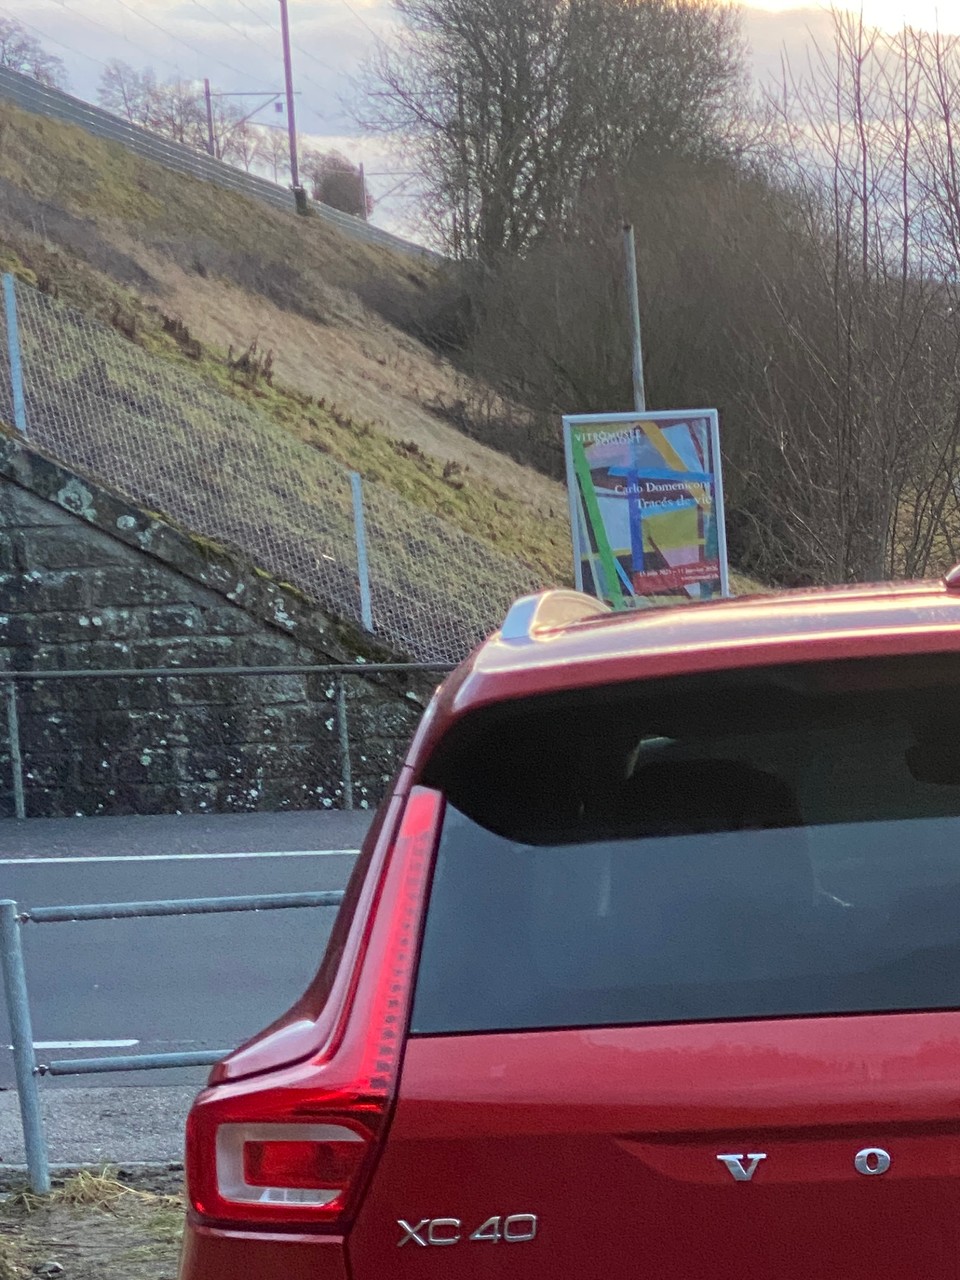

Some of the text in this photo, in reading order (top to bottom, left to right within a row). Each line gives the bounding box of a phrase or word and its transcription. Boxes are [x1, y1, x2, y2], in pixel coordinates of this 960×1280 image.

[614, 482, 643, 495] Carlo
[637, 495, 712, 509] Tracés de vie
